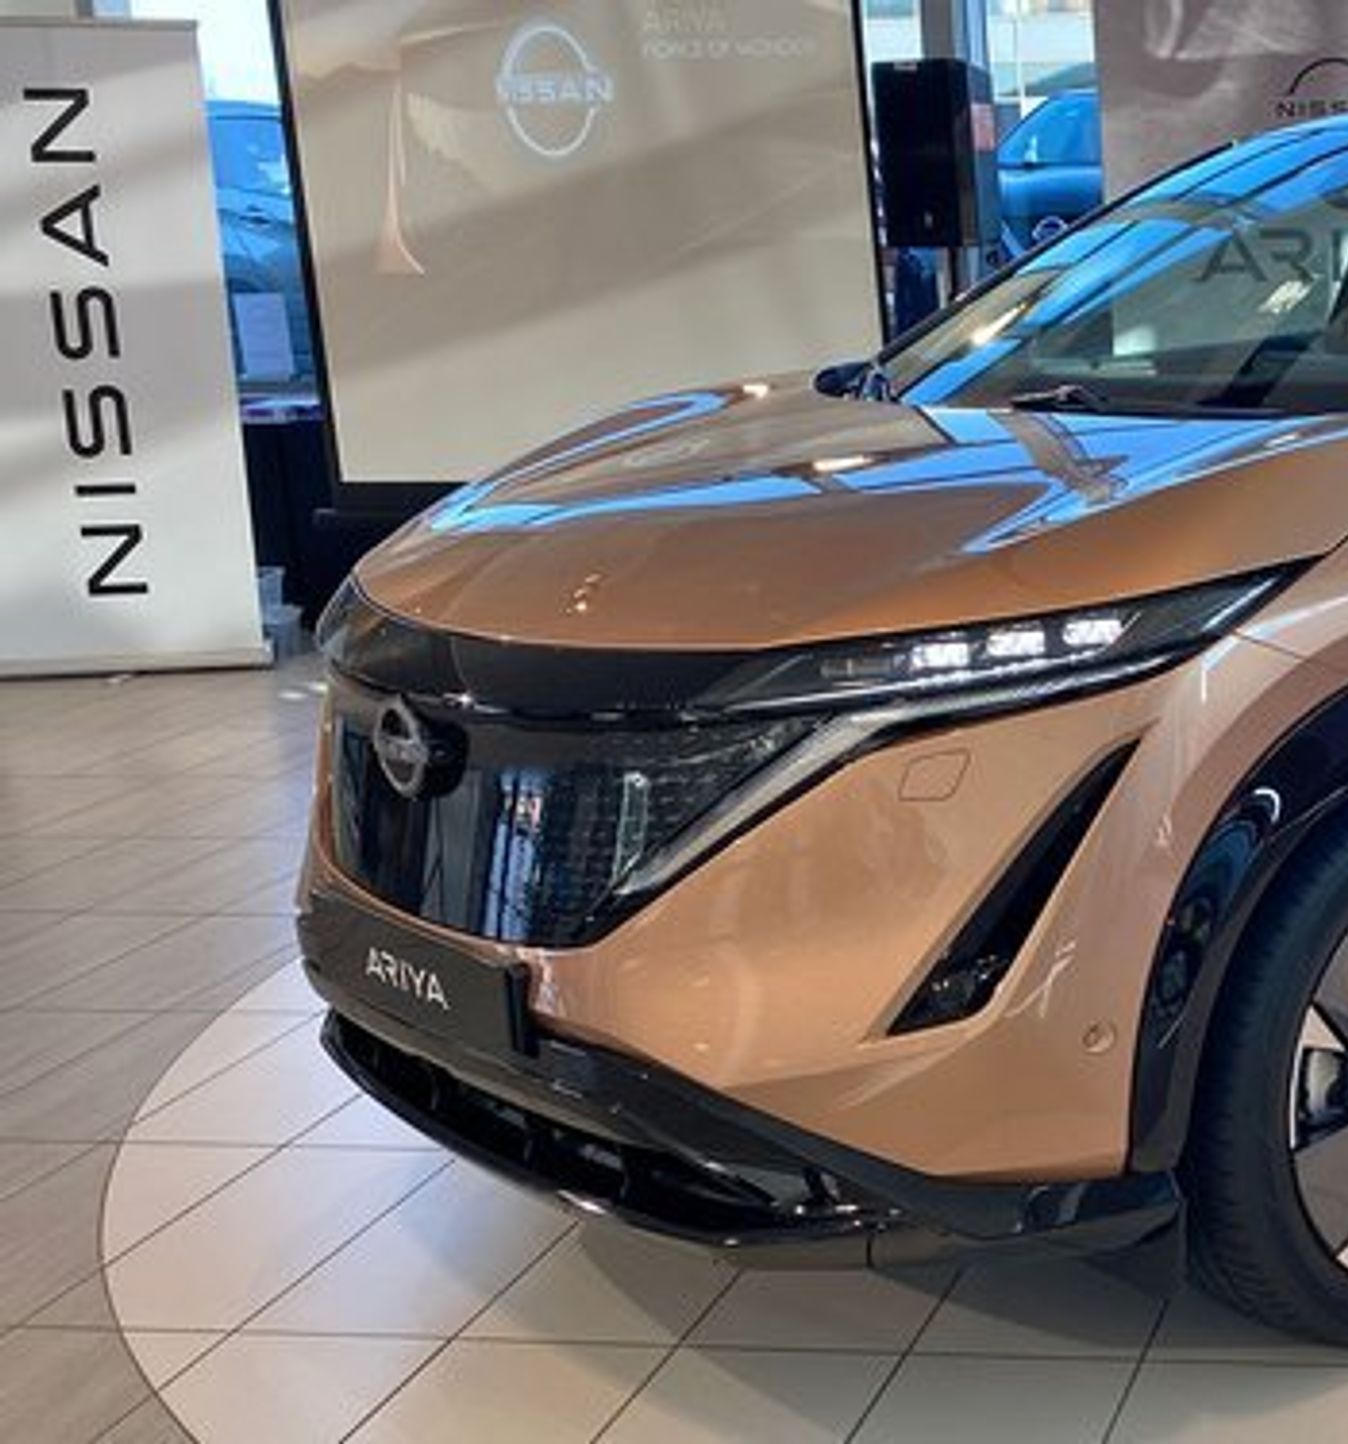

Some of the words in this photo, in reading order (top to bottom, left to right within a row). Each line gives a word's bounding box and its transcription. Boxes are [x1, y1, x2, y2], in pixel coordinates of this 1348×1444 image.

[1195, 227, 1348, 283] ARI
[22, 87, 149, 596] NISSAN
[365, 946, 451, 1011] ARIYA
